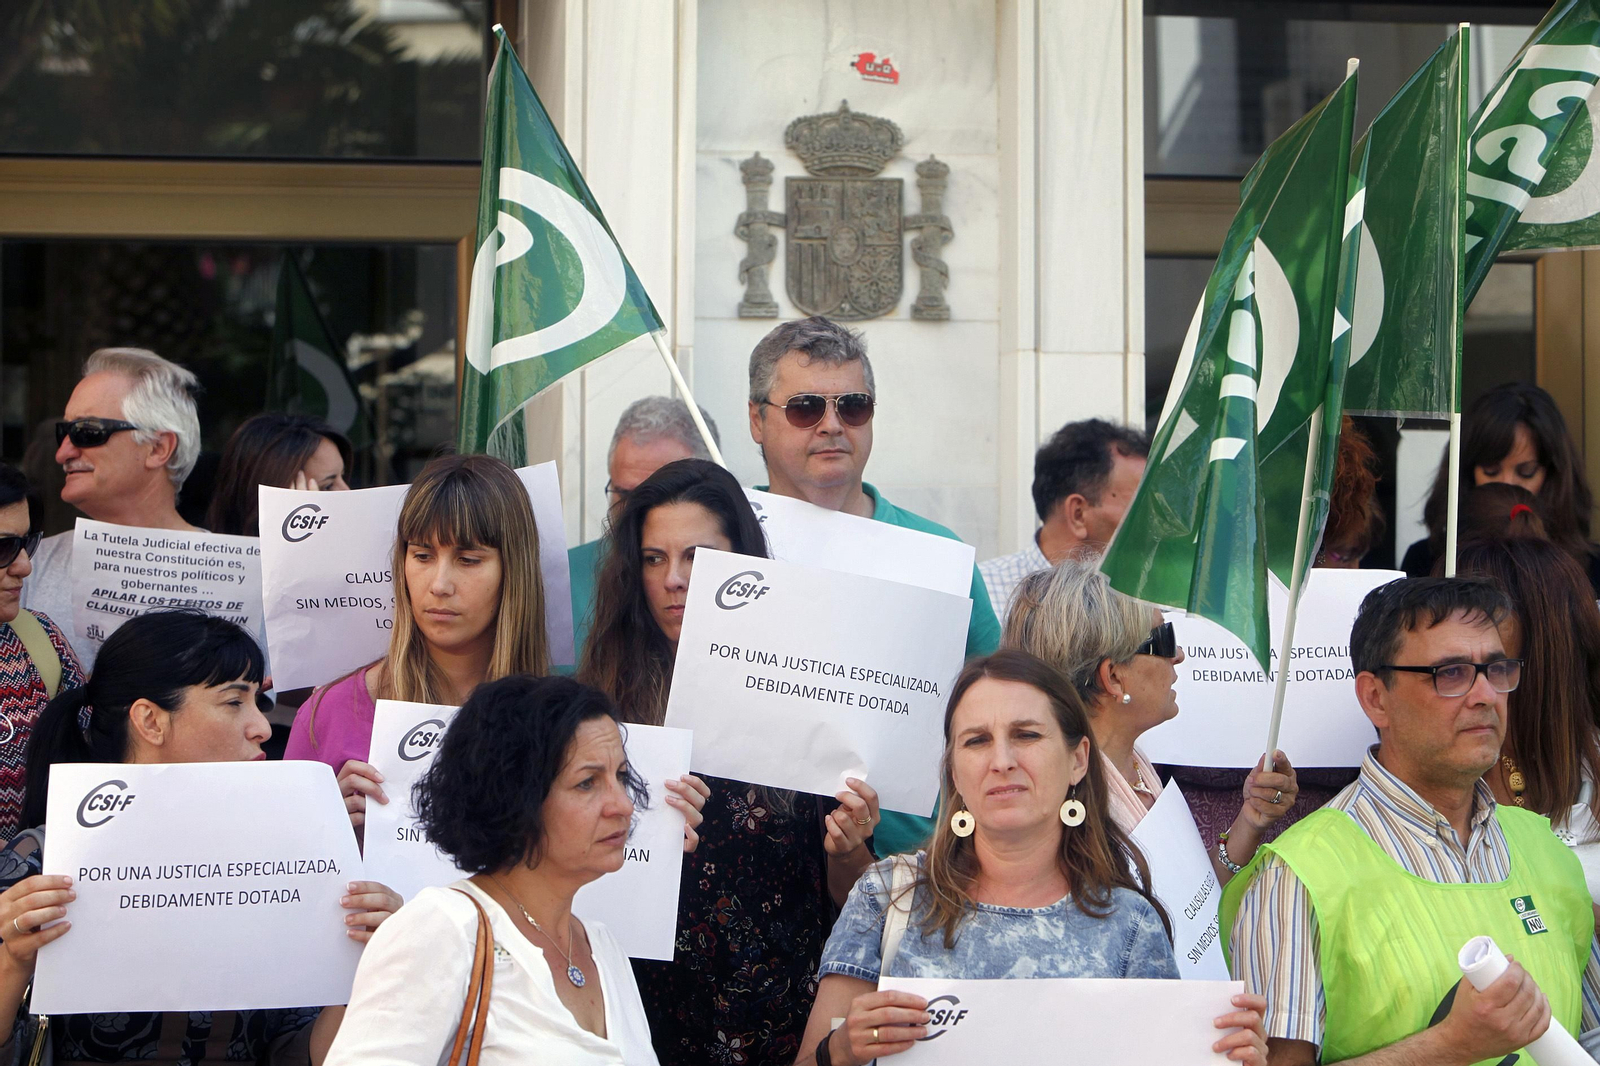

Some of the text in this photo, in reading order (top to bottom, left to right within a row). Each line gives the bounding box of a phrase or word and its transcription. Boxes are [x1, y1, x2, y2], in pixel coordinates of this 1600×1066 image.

[84, 530, 260, 556] La Tutela Judicial efectiva de
[96, 547, 245, 570] nuestra Constitución es,
[94, 560, 245, 584] para nuestros políticos y
[345, 570, 392, 584] CLAUS
[121, 578, 198, 594] gobernantes
[92, 588, 244, 610] APILAR LOS PLEITOS DE
[296, 598, 320, 610] SIN
[325, 596, 386, 610] MEDIOS,
[1188, 646, 1217, 658] UNA
[1290, 646, 1350, 659] SPECIALI
[710, 643, 941, 698] POR UNA JUSTICIA ESPECIALIZADA,
[1296, 668, 1354, 682] DOTADA
[745, 675, 909, 716] DEBIDAMENTE DOTADA
[396, 828, 420, 842] SIN
[78, 859, 341, 882] POR UNA JUSTICIA ESPECIALIZADA,
[120, 888, 301, 909] DEBIDAMENTE DOTADA
[1187, 948, 1203, 964] SIN
